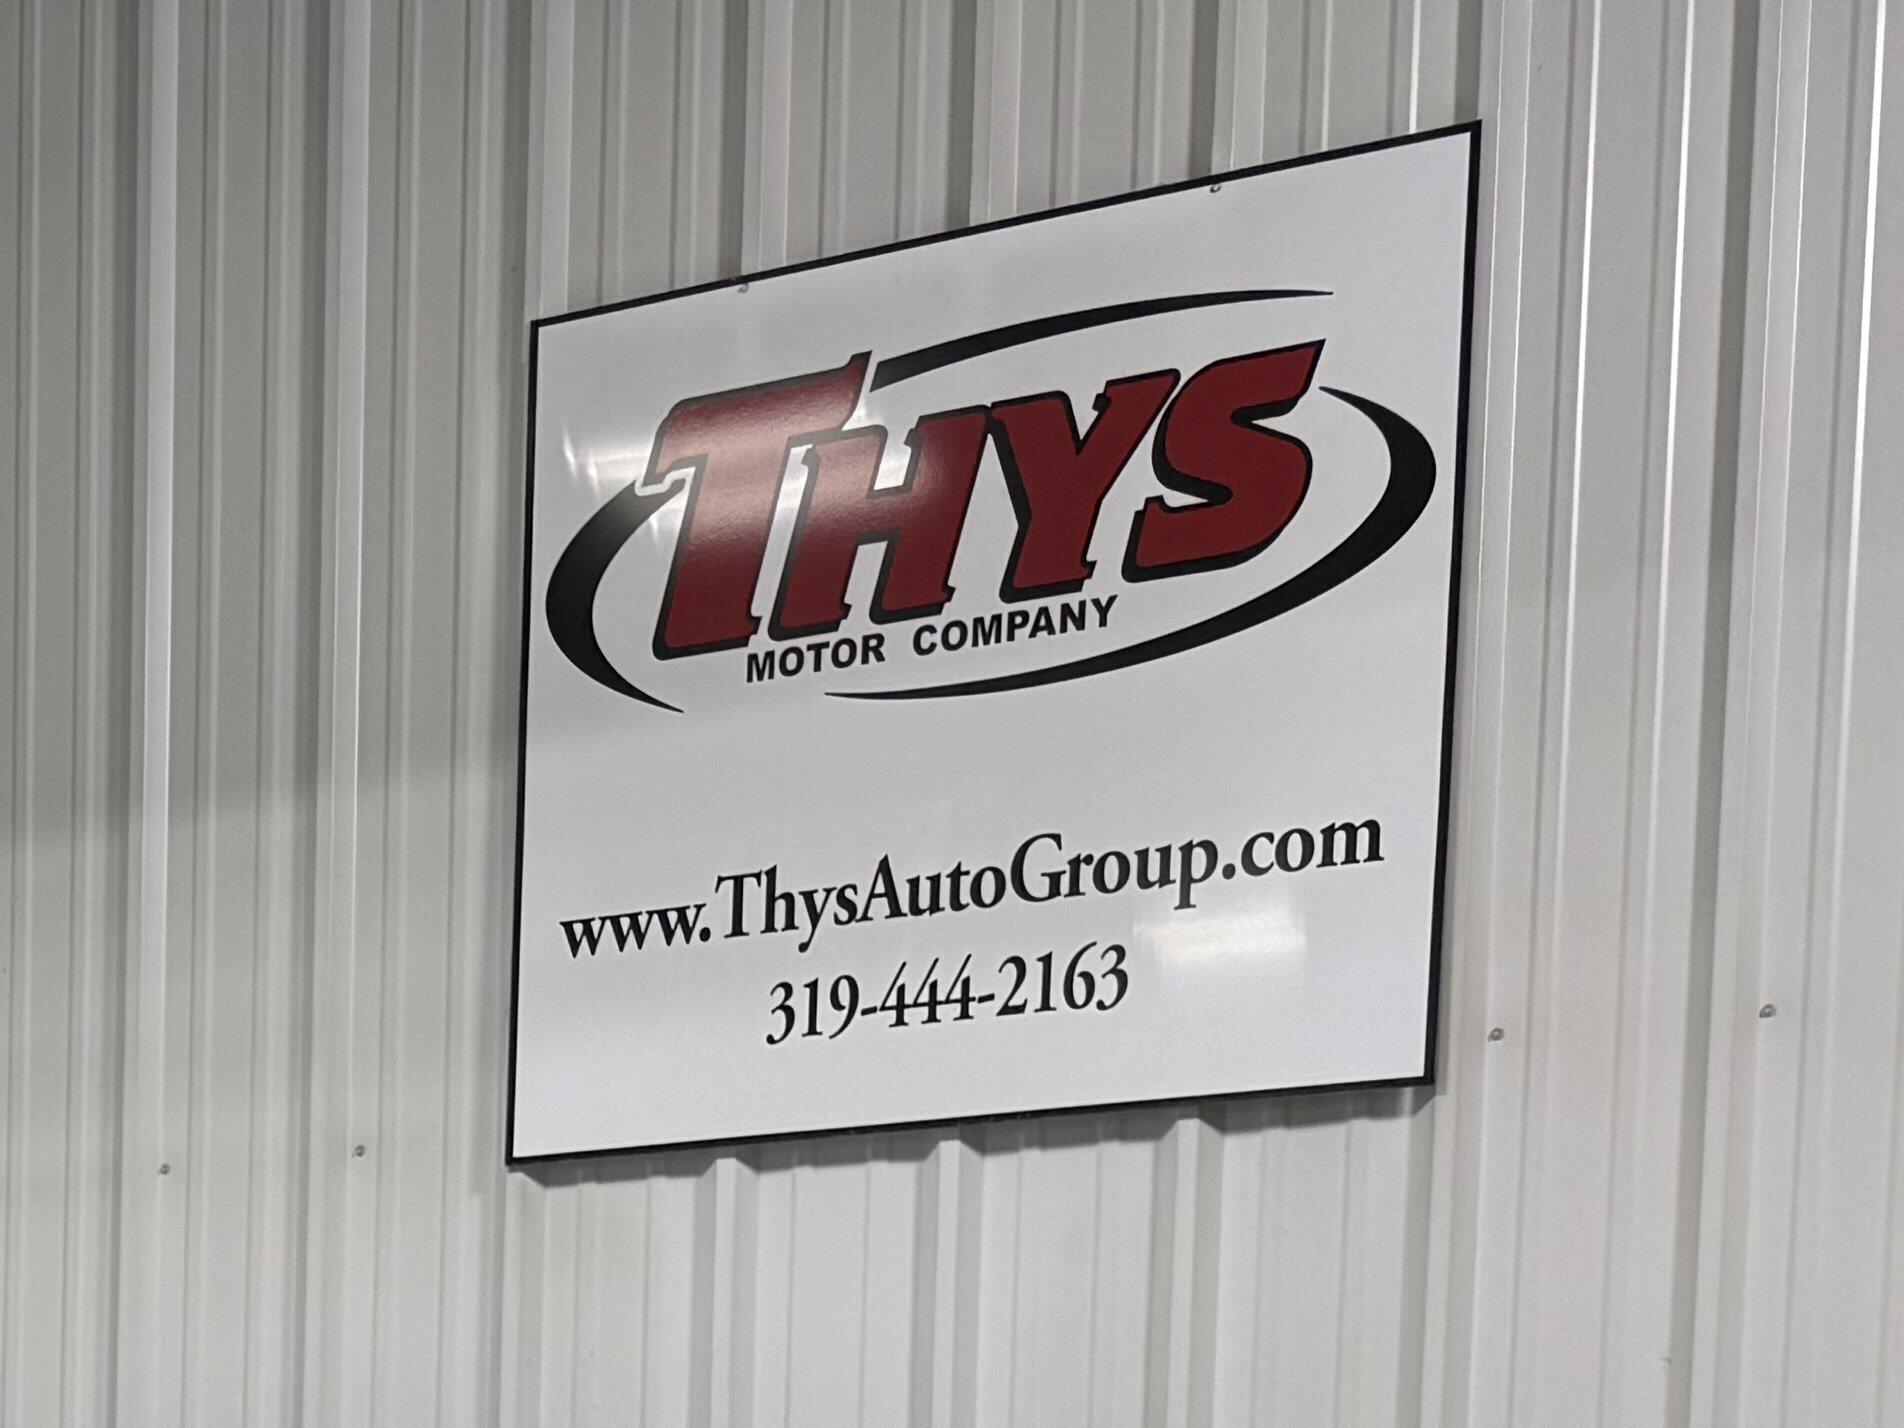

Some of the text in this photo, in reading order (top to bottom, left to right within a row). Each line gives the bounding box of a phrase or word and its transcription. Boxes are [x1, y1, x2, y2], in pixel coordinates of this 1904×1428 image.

[638, 338, 1326, 660] THYS
[747, 595, 1118, 684] MOTOR COMPANY
[560, 818, 1386, 960] www.ThysAutoGroup.com
[766, 942, 1130, 1046] 319-444-2163
